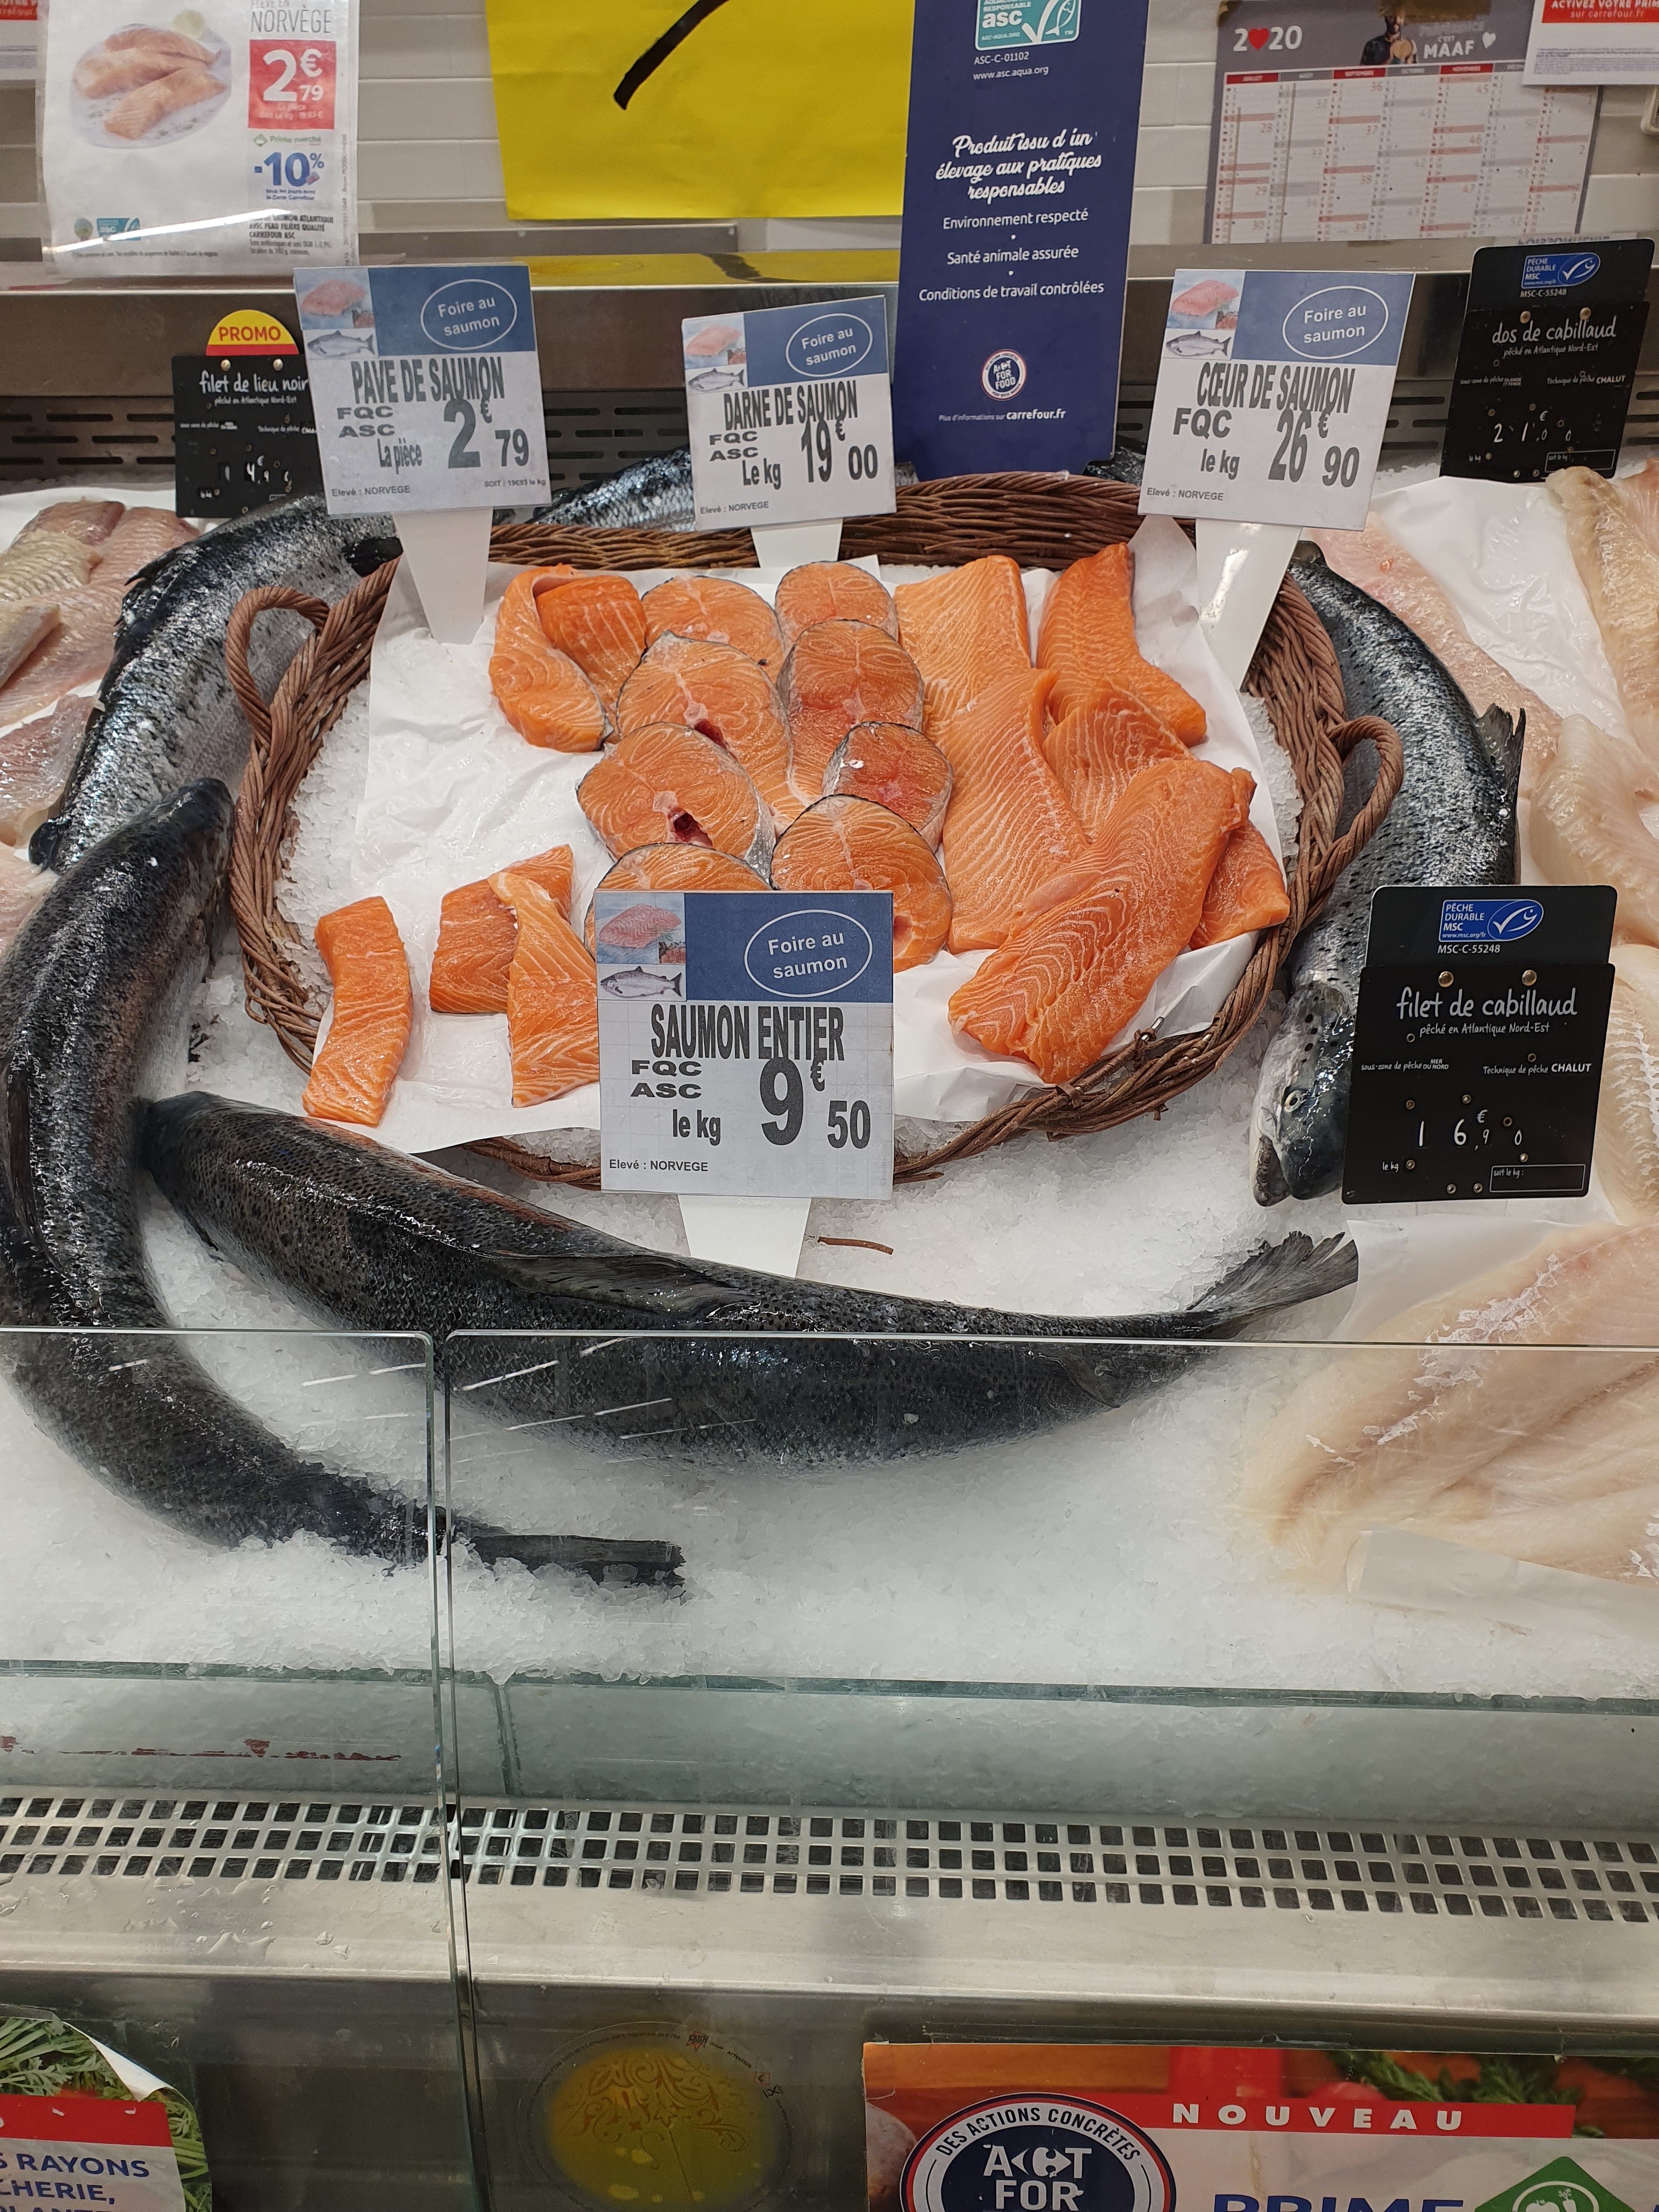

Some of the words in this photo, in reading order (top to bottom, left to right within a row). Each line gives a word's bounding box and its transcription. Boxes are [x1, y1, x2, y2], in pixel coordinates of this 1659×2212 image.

[983, 2, 1031, 12] RESPONSABLE
[1588, 9, 1644, 18] carrefour.fr
[1599, 0, 1631, 8] VOTRE
[251, 4, 332, 33] NORVÈGE
[982, 10, 1023, 28] asc
[974, 51, 1030, 65] ASC-C-01102
[1423, 40, 1475, 59] MAAF
[952, 133, 1018, 158] Produit
[1018, 134, 1050, 151] issu
[935, 161, 994, 184] élevage
[996, 161, 1025, 174] aux
[1026, 152, 1102, 179] pratiques
[968, 176, 1066, 205] responsables
[943, 212, 1034, 230] Environnement
[1036, 207, 1089, 224] respecté
[947, 251, 981, 265] Santé
[983, 247, 1030, 263] animale
[1032, 245, 1079, 259] assurée
[1527, 257, 1549, 266] PÊCHE
[1526, 264, 1556, 273] DURABLE
[918, 286, 981, 301] Conditions
[983, 285, 998, 299] de
[1001, 283, 1038, 296] travail
[1040, 281, 1105, 295] contrôlées
[1520, 289, 1567, 298] MSC-C-55248
[438, 301, 475, 318] Foire
[478, 297, 496, 310] au
[1304, 309, 1344, 324] Foire
[1348, 305, 1366, 318] au
[219, 326, 281, 342] PROMO
[443, 316, 500, 336] saumon
[1304, 325, 1365, 344] saumon
[1492, 322, 1517, 344] dos
[1522, 320, 1541, 342] de
[1545, 315, 1617, 341] cabillaud
[801, 334, 835, 350] Foire
[838, 328, 854, 339] au
[805, 343, 856, 366] saumon
[1533, 346, 1567, 356] Atlantique
[1568, 344, 1599, 353] Nord-Est
[199, 369, 229, 394] filet
[233, 371, 250, 393] de
[253, 373, 279, 392] lieu
[282, 375, 308, 391] noir
[351, 360, 399, 404] PAVE
[400, 359, 427, 402] DE
[429, 356, 505, 402] SAUMON
[995, 377, 1016, 390] FOOD
[996, 369, 1012, 381] FOR
[1596, 375, 1626, 384] CHALUT
[1197, 362, 1249, 408] CŒUR
[1249, 364, 1277, 409] DE
[1276, 365, 1356, 414] SAUMON
[337, 405, 394, 420] FQC
[723, 389, 771, 431] DARNE
[774, 387, 794, 426] DE
[797, 380, 858, 424] SAUMON
[1006, 408, 1066, 420] carrefour.fr
[338, 424, 396, 438] ASC
[1173, 408, 1232, 439] FQC
[495, 428, 529, 467] 79
[709, 431, 759, 445] FQC
[377, 438, 393, 467] La
[709, 447, 759, 462] ASC
[742, 459, 760, 486] Le
[763, 458, 781, 490] kg
[848, 444, 878, 480] 00
[1200, 449, 1215, 473] le
[1219, 449, 1240, 481] kg
[1322, 445, 1360, 488] 90
[331, 487, 357, 497] Elevé
[365, 485, 410, 495] NORVEGE
[1146, 487, 1170, 498] Elevé
[1178, 489, 1224, 501] NORVEGE
[699, 505, 721, 515] Elevé
[729, 501, 769, 512] NORVEGE
[1446, 902, 1474, 912] PÊCHE
[1444, 912, 1485, 922] DURABLE
[1443, 923, 1463, 932] MSC
[768, 937, 816, 955] Foire
[821, 932, 844, 946] au
[1437, 944, 1500, 954] MSC-C-55248
[772, 955, 848, 979] saumon
[1396, 986, 1443, 1020] filet
[1449, 989, 1474, 1017] de
[1482, 987, 1578, 1017] cabillaud
[651, 1003, 751, 1060] SAUMON
[758, 1006, 845, 1061] ENTIER
[1419, 1024, 1446, 1038] pêché
[1448, 1026, 1459, 1034] en
[1462, 1022, 1506, 1036] Atlantique
[1509, 1022, 1550, 1034] Nord-Est
[631, 1059, 702, 1077] FQC
[1394, 1061, 1402, 1070] de
[1403, 1060, 1422, 1073] pêche
[1482, 1065, 1517, 1077] Technique
[1518, 1065, 1527, 1074] de
[1528, 1063, 1548, 1075] pêche
[1551, 1063, 1592, 1073] CHALUT
[630, 1082, 702, 1099] ASC
[673, 1109, 690, 1138] le
[697, 1109, 721, 1146] kg
[827, 1100, 871, 1149] 50
[609, 1159, 639, 1170] Elevé
[650, 1160, 709, 1172] NORVEGE
[1382, 1162, 1389, 1171] le
[1390, 1162, 1399, 1173] kg
[1493, 1169, 1505, 1177] soit
[1513, 1169, 1520, 1179] kg
[1172, 2103, 1463, 2131] NOUVEAU
[935, 2131, 968, 2156] DES
[966, 2107, 1041, 2136] ACTIONS
[1047, 2108, 1141, 2162] CONCRÈTES
[16, 2153, 149, 2177] RAYONS
[995, 2180, 1085, 2212] FOR
